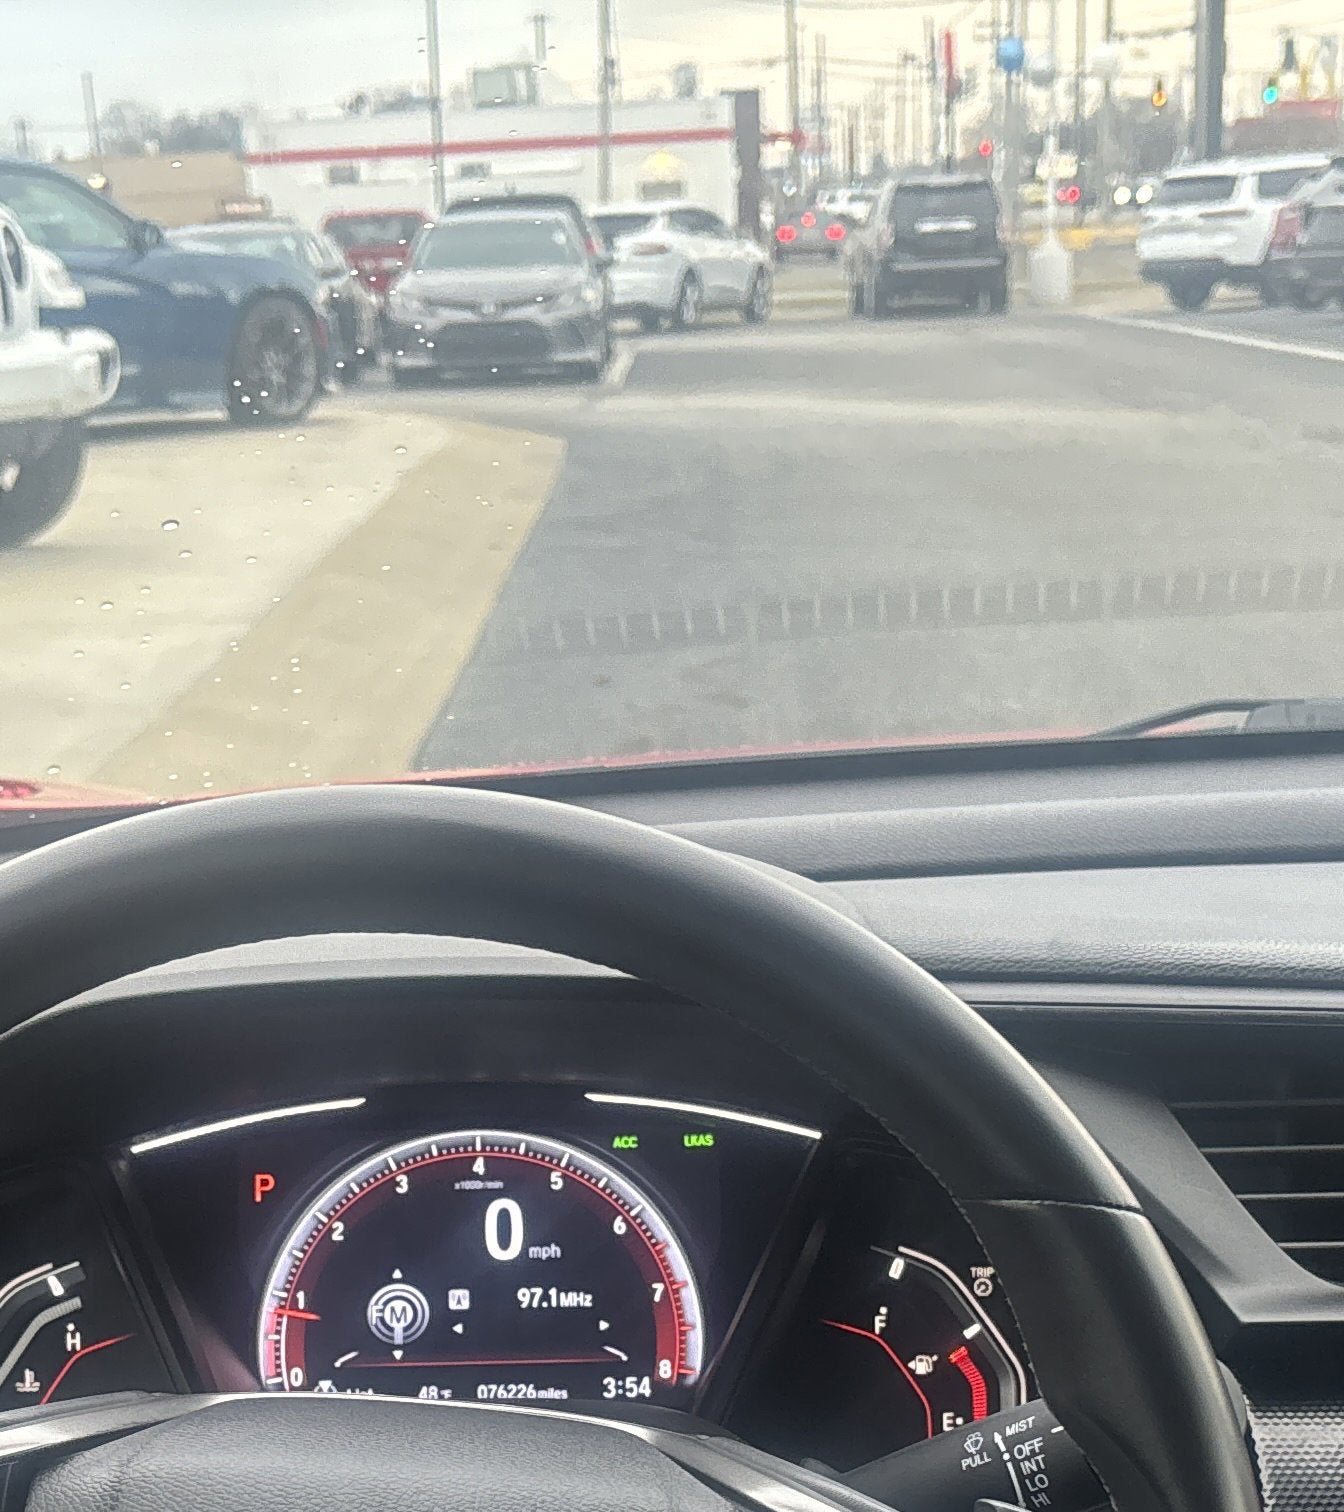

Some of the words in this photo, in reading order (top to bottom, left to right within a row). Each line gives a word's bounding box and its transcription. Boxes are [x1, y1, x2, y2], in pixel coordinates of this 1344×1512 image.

[613, 1136, 638, 1148] ACC
[684, 1134, 714, 1148] LKAS
[472, 1156, 485, 1176] 4
[254, 1173, 275, 1203] P
[395, 1175, 410, 1194] 3
[550, 1171, 563, 1191] 5
[332, 1221, 345, 1241] 2
[484, 1198, 525, 1261] 0
[528, 1243, 562, 1261] mph
[614, 1216, 626, 1235] 6
[970, 1267, 995, 1278] TRIP
[296, 1291, 306, 1310] 1
[652, 1283, 665, 1302] 7
[874, 1315, 887, 1335] F
[66, 1331, 81, 1352] H
[290, 1367, 304, 1388] 0
[658, 1359, 672, 1379] 8
[602, 1375, 652, 1398] 3:54
[943, 1411, 955, 1432] E
[1005, 1416, 1036, 1438] MIST
[1013, 1437, 1044, 1460] OFF
[961, 1451, 992, 1471] PULL
[1019, 1454, 1046, 1476] INT
[1025, 1473, 1049, 1493] LO
[1030, 1493, 1052, 1509] HI
